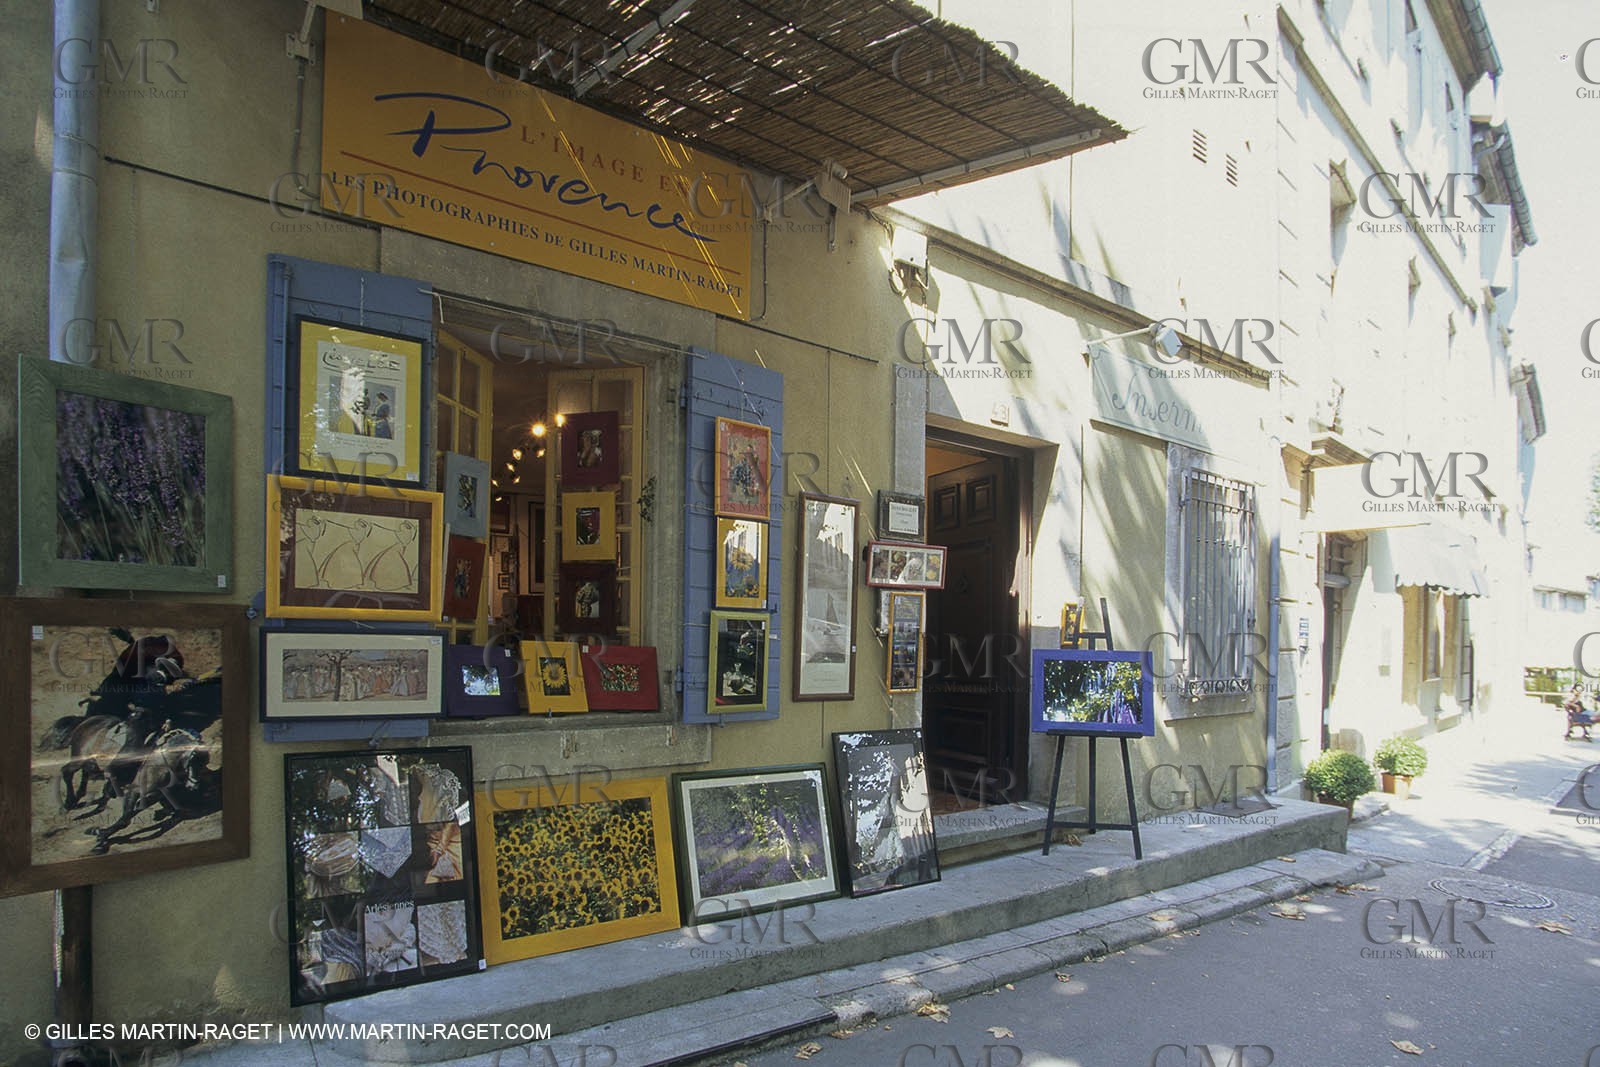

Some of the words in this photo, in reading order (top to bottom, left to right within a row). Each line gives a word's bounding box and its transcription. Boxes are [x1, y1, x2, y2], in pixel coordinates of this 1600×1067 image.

[331, 170, 366, 191] LES
[372, 179, 540, 241] PHOTOGRAPHIES
[544, 231, 565, 248] DE
[568, 238, 629, 267] GILLES
[632, 255, 743, 299] MARTIN-RAGET
[374, 92, 720, 243] Provence
